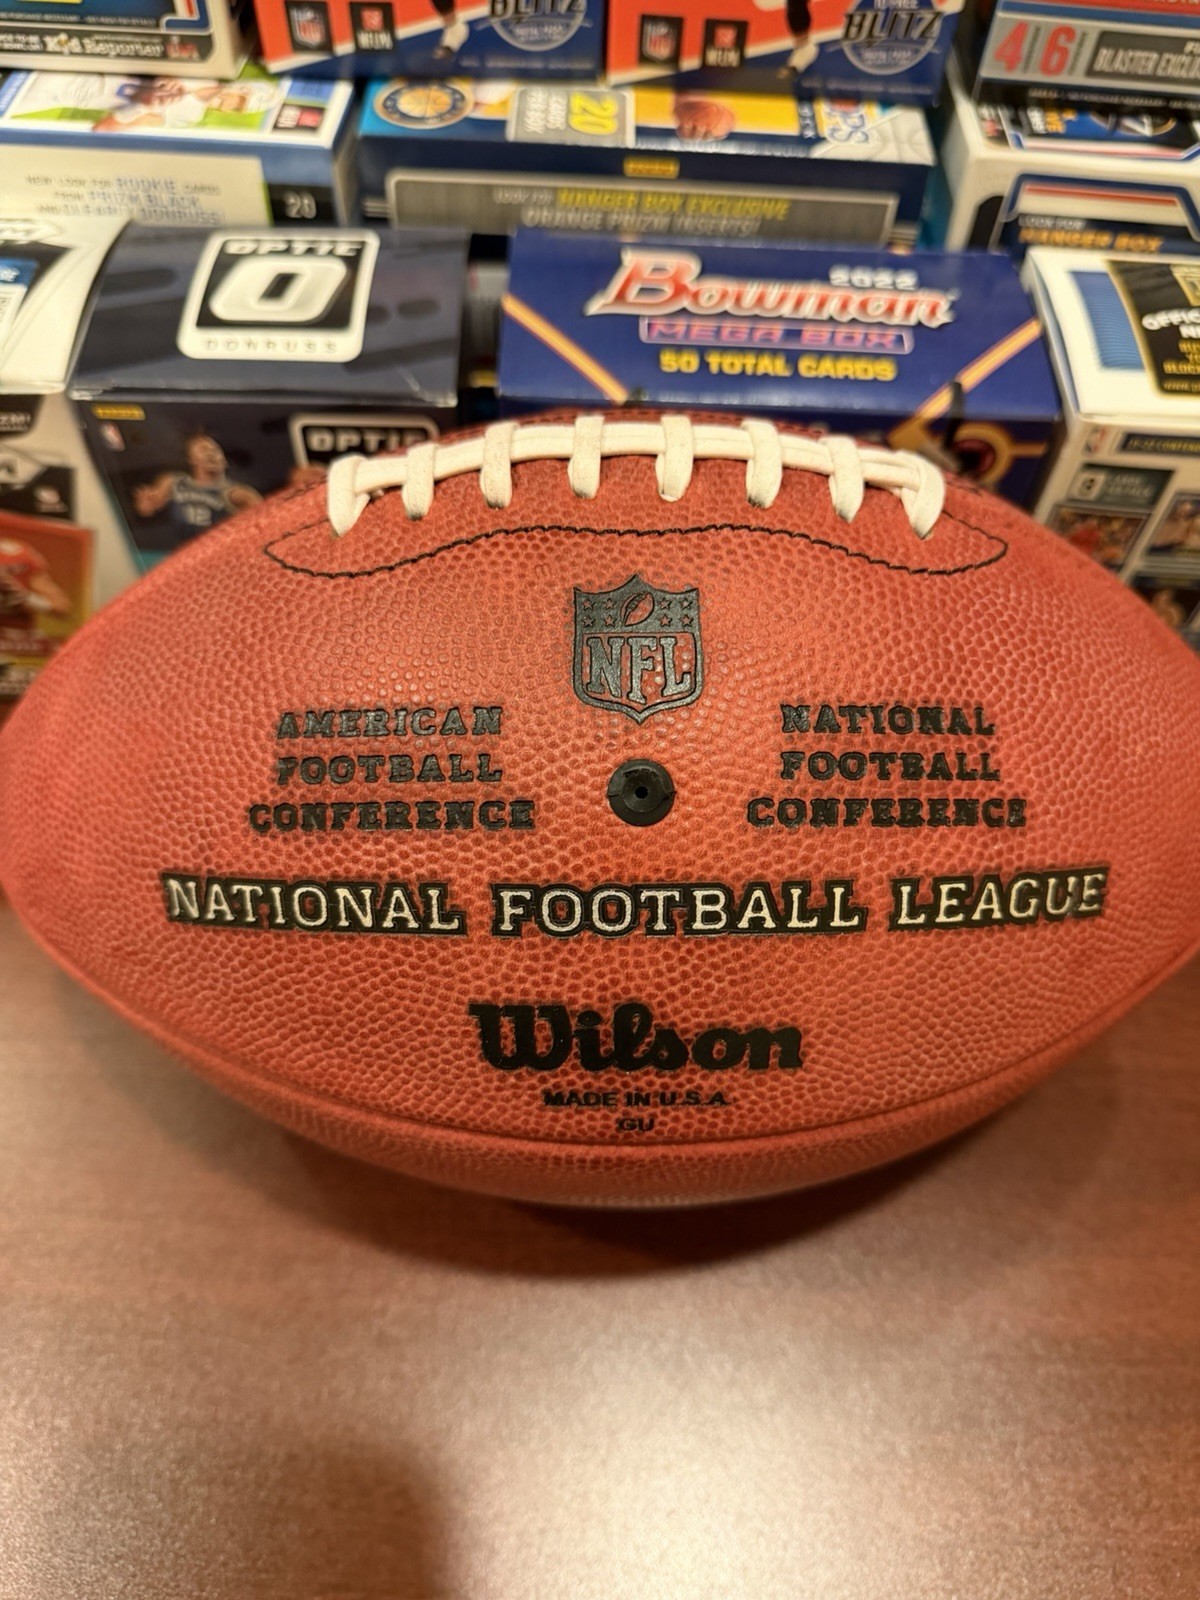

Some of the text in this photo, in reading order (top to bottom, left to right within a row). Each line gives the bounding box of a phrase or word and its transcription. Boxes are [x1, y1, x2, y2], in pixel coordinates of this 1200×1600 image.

[843, 11, 941, 43] BLITZ
[995, 21, 1028, 73] 4
[1039, 25, 1077, 77] 6
[1093, 47, 1159, 75] BLASTER
[568, 91, 619, 135] 20
[115, 176, 177, 191] ROOKIE
[223, 239, 363, 257] OPTIC
[1018, 228, 1164, 252] HANGER BOX
[584, 246, 961, 329] Bowman
[830, 265, 918, 291] 2022
[205, 338, 338, 354] DONRUSS
[647, 319, 898, 350] MEGA BOX
[659, 349, 897, 381] 50 TOTAL CARDS
[586, 636, 692, 704] NFL
[277, 706, 503, 739] AMERICAN
[780, 704, 996, 736] NATIONAL
[277, 754, 503, 786] FOOTBALL
[780, 751, 1001, 782] FOOTBALL
[248, 800, 535, 832] CONFERENCE
[747, 797, 1027, 829] CONFERENCE
[163, 867, 1109, 938] NATIONAL FOOTBALL LEAGUE
[468, 1002, 804, 1071] Wilson
[543, 1089, 618, 1107] MADE
[625, 1090, 651, 1107] IN
